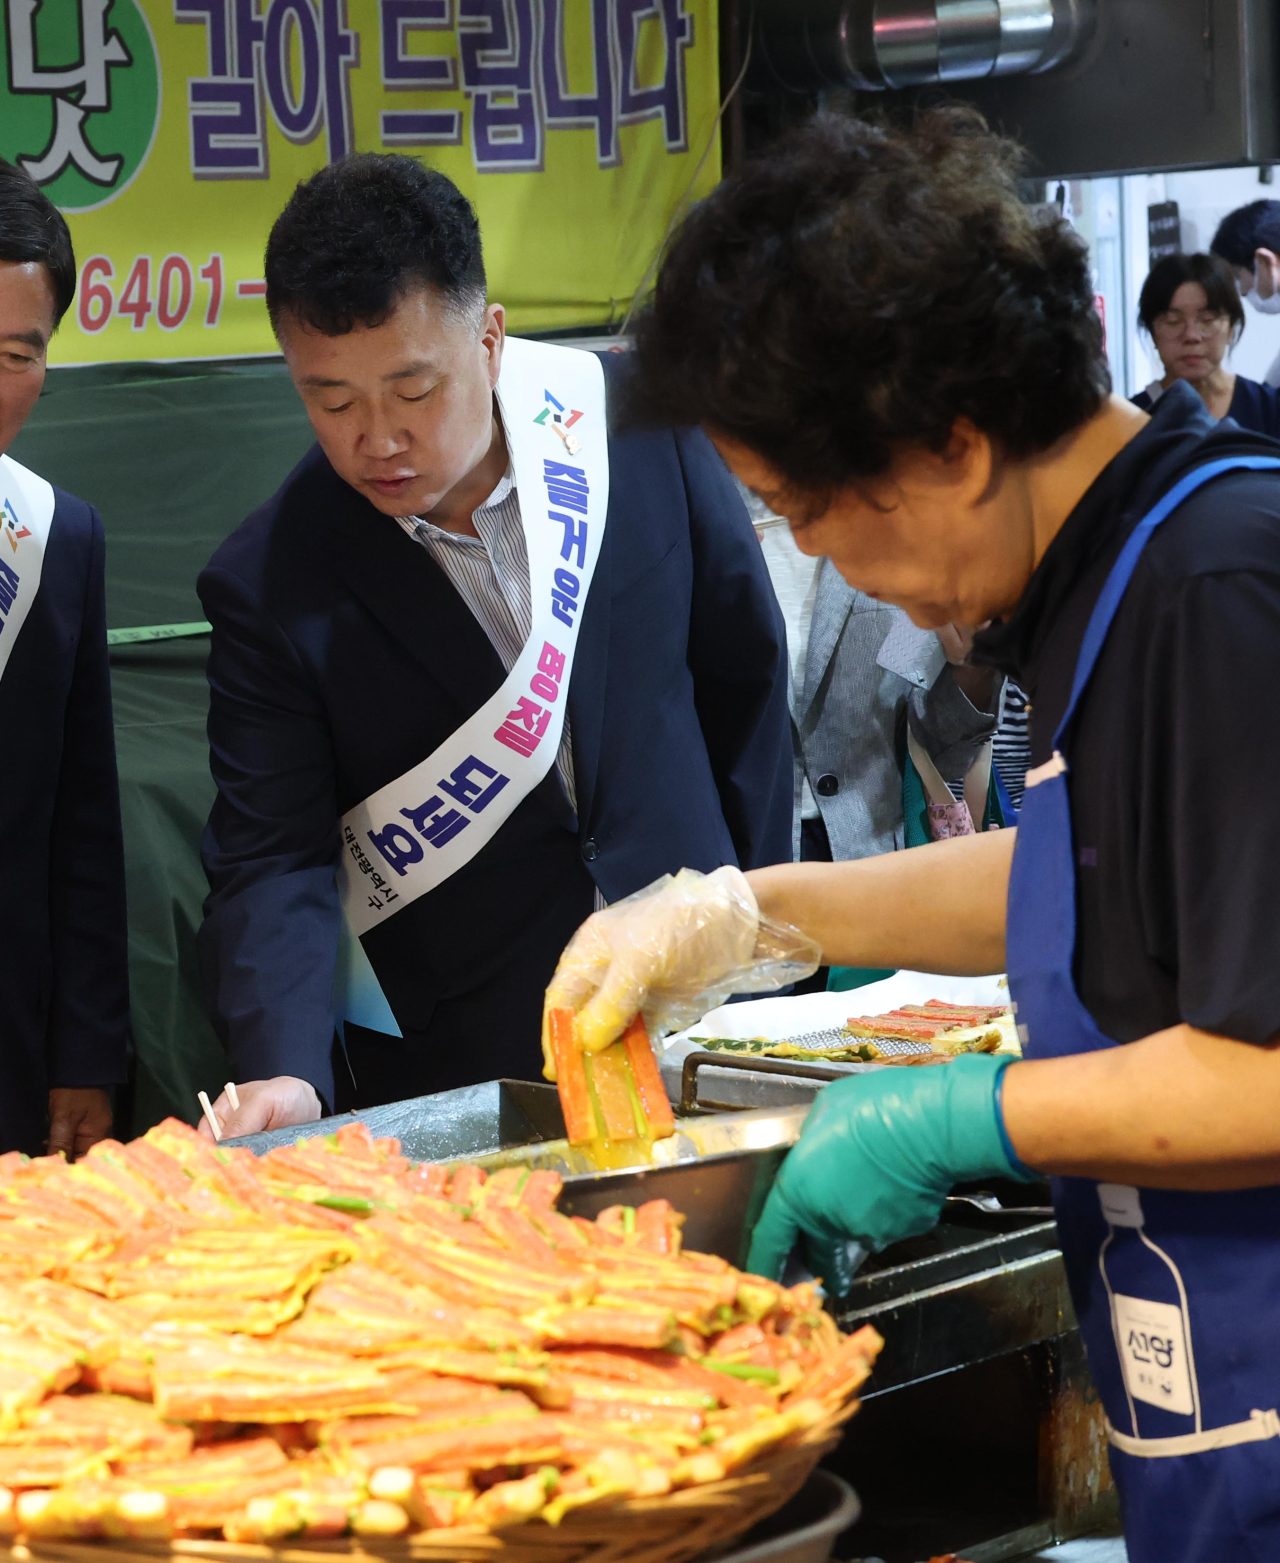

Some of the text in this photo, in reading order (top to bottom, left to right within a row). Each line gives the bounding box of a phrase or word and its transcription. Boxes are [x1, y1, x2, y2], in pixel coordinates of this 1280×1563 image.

[173, 0, 360, 180] 갈아
[381, 0, 694, 173] 드립니다
[367, 458, 590, 877] 즐거운 명절 되세요
[344, 826, 399, 902] 대전광역시
